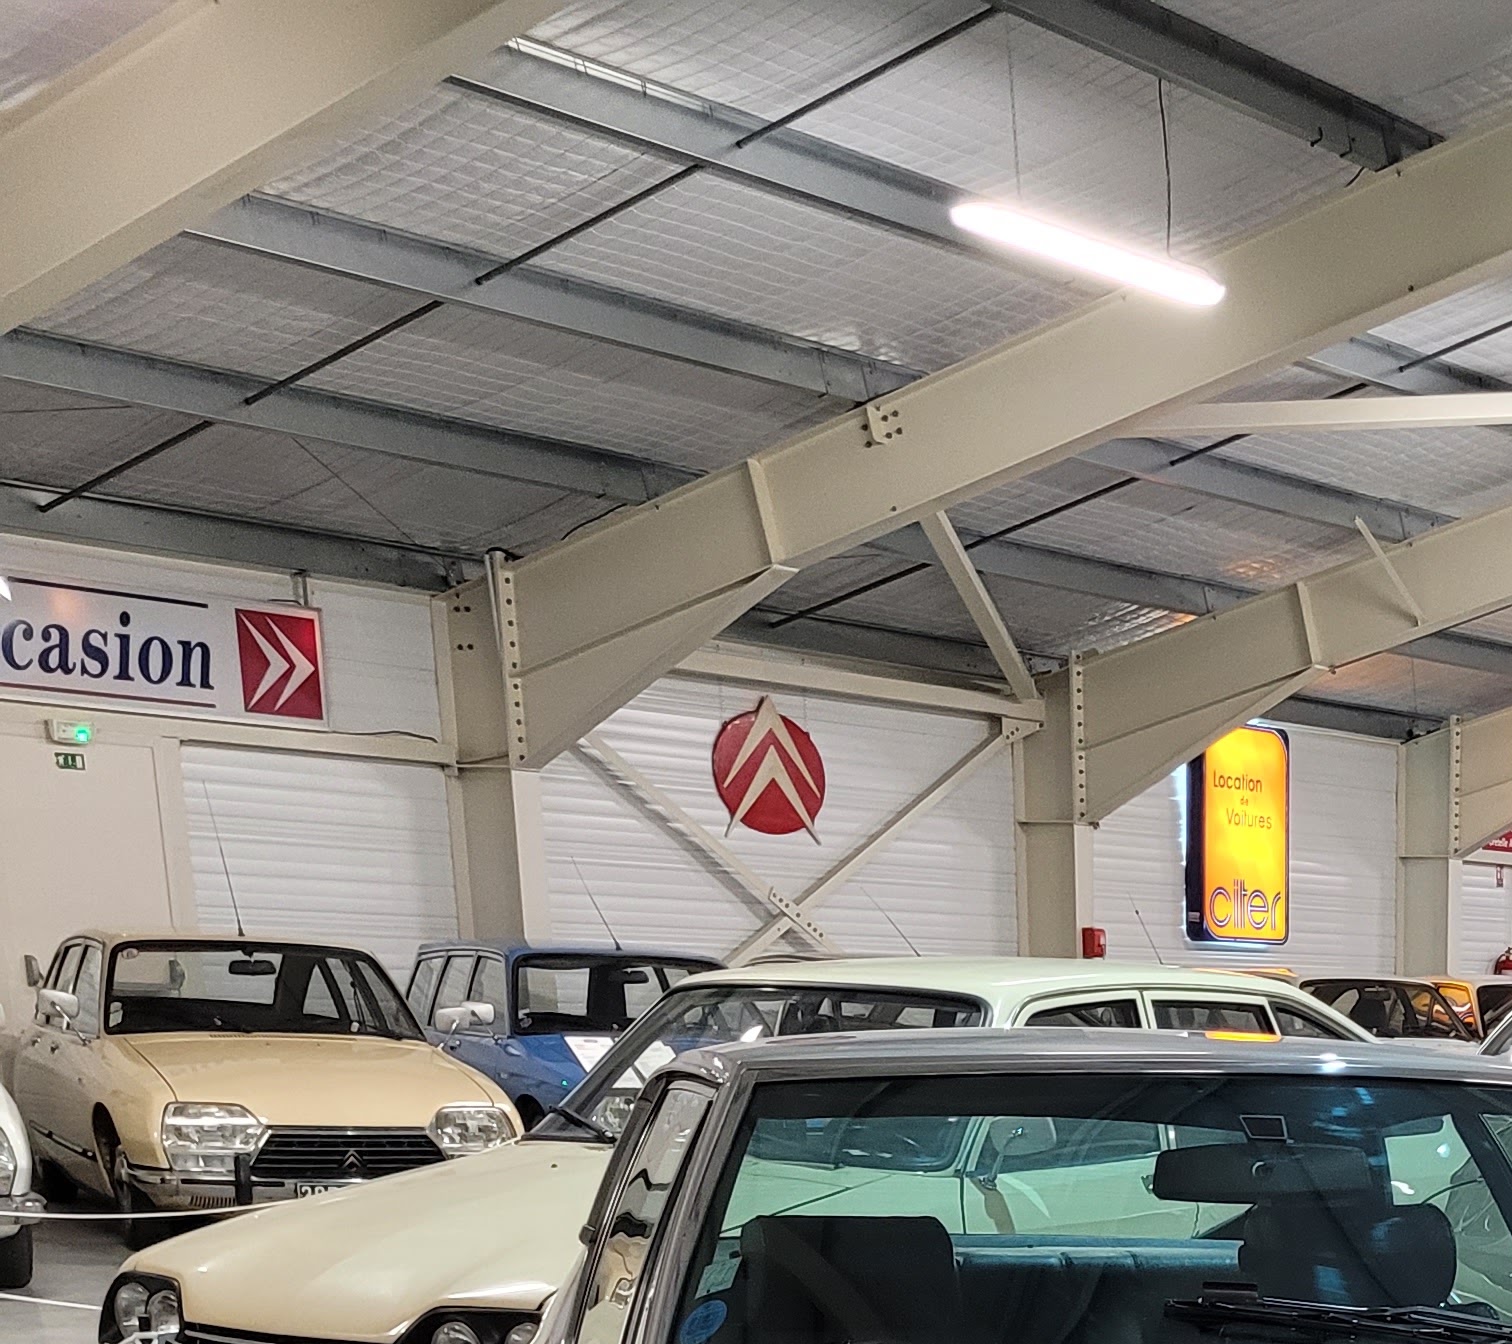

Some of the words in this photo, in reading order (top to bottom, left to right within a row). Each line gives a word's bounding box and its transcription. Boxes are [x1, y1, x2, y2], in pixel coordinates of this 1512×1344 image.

[1213, 770, 1263, 794] Location
[1239, 795, 1249, 807] de
[1226, 807, 1273, 830] Voitures
[1209, 878, 1281, 931] citer
